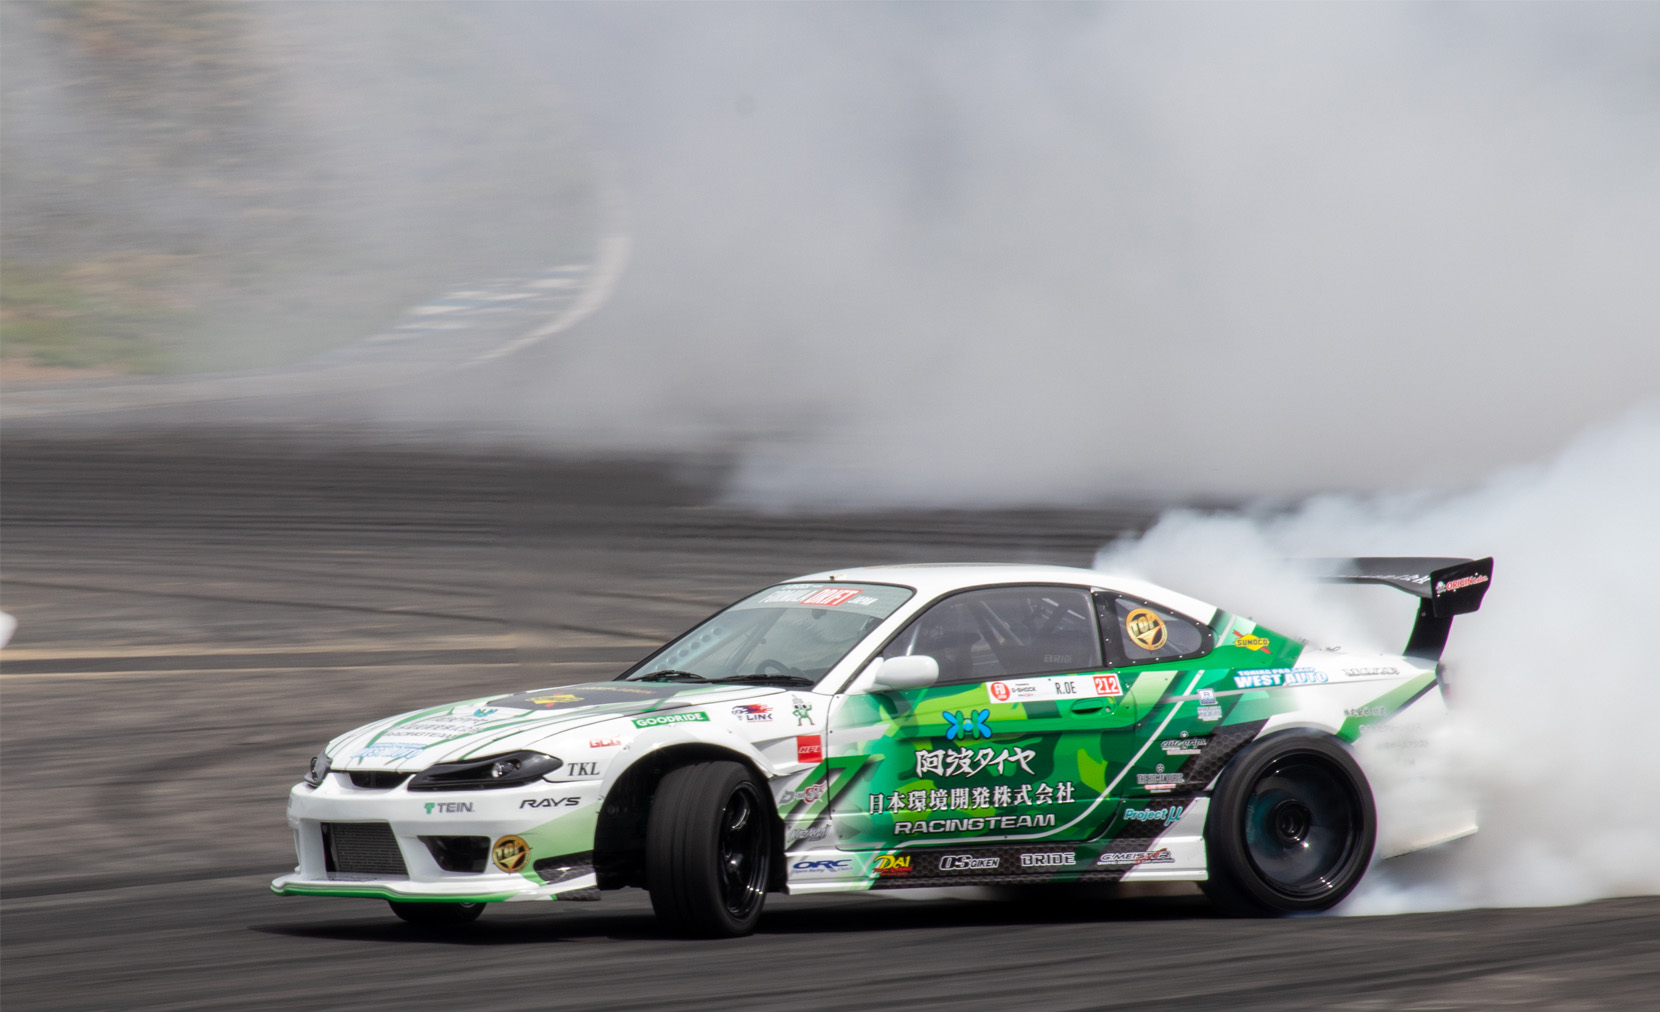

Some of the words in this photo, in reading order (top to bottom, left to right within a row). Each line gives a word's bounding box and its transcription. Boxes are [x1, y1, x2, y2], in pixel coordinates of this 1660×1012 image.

[1445, 577, 1473, 591] ORIGIN
[803, 588, 857, 605] DRIFT
[1236, 637, 1269, 647] SUNOCO
[1095, 677, 1119, 695] 212
[1233, 674, 1282, 689] WEST
[1284, 671, 1329, 685] AUTO
[1055, 681, 1077, 695] R.OE
[636, 712, 704, 727] GOODRIDE
[746, 713, 773, 721] LINK
[567, 761, 600, 777] TKL
[915, 747, 1036, 778] 阿波タイヤ
[519, 796, 581, 809] RAYS
[869, 781, 1076, 815] 日本環境開発株式会社
[1123, 808, 1169, 822] Project
[894, 813, 1056, 835] RACINGTEAM
[793, 859, 852, 869] ORC
[874, 855, 911, 869] DAI
[1020, 852, 1076, 867] BRIDE
